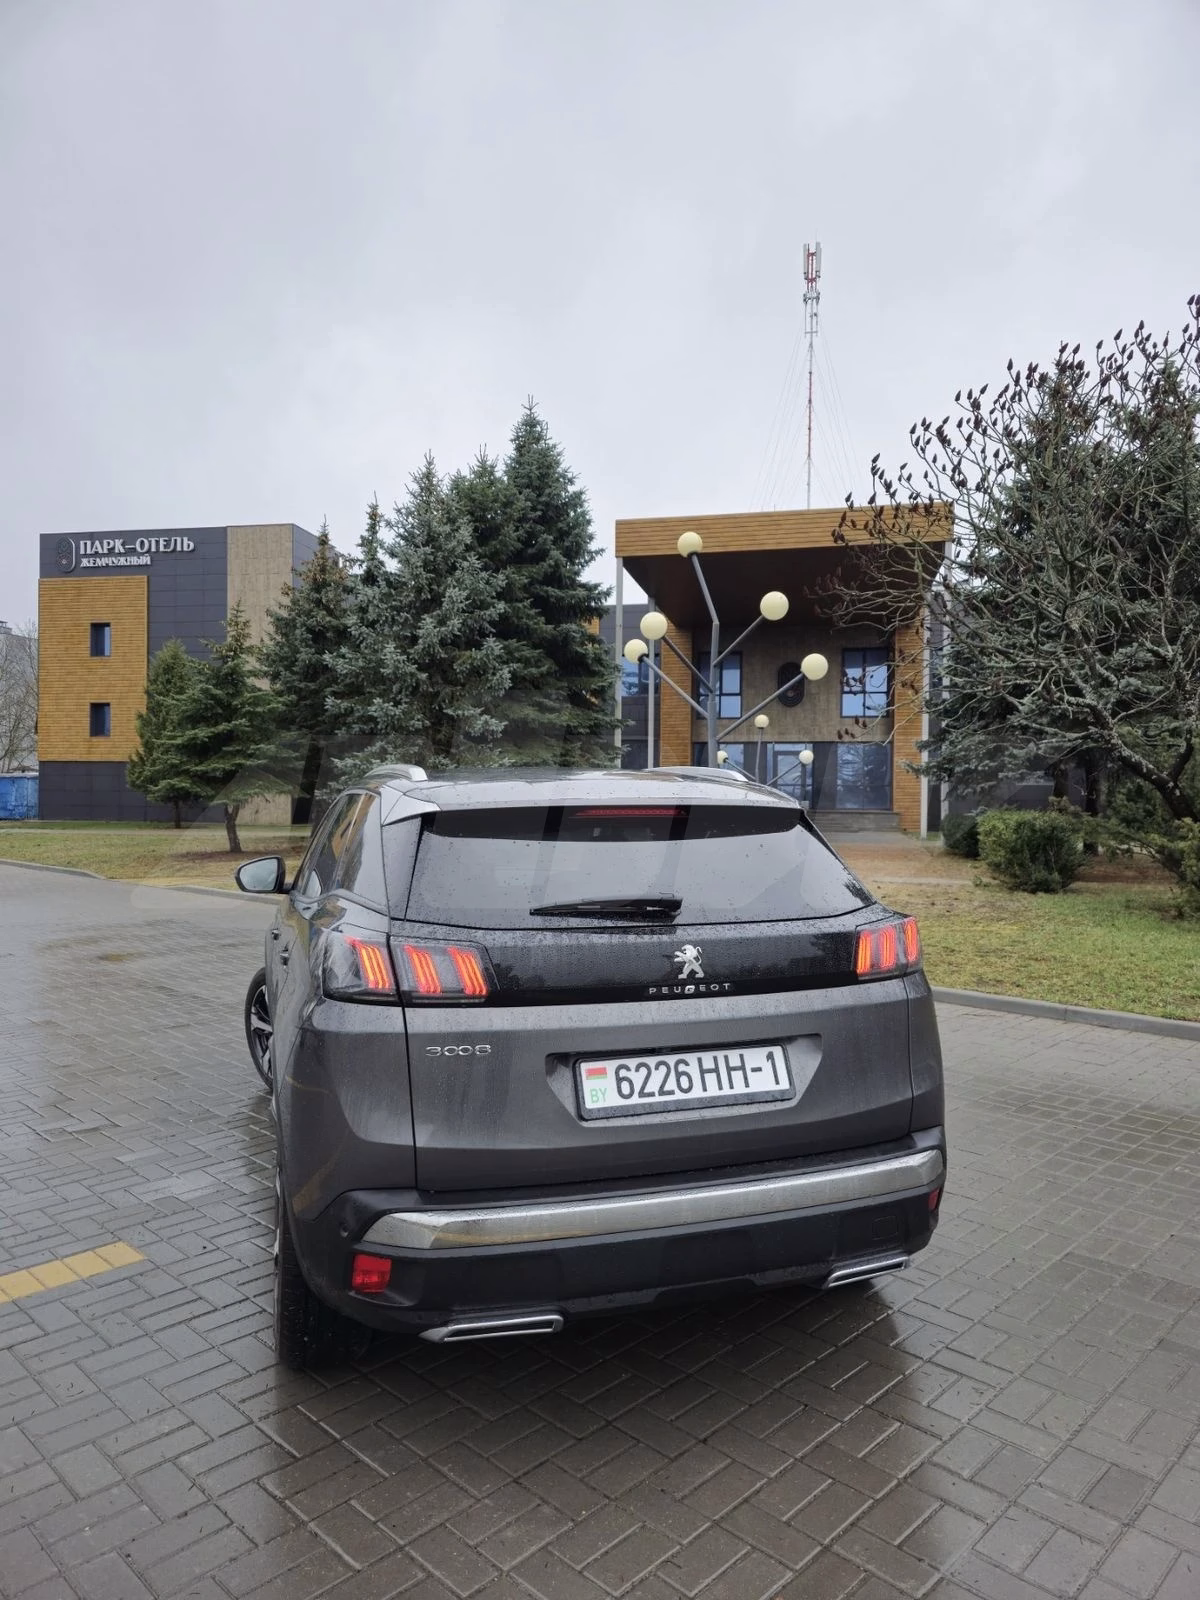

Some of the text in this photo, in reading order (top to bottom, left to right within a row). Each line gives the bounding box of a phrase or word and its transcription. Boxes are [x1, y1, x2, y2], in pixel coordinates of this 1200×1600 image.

[80, 536, 195, 555] ПАРК-ОТЕЛЬ
[80, 553, 151, 568] ЖЕМЧУЖНЫЙ
[648, 983, 731, 995] PEUGEOT
[425, 1044, 492, 1057] 3008
[590, 1087, 608, 1104] BY
